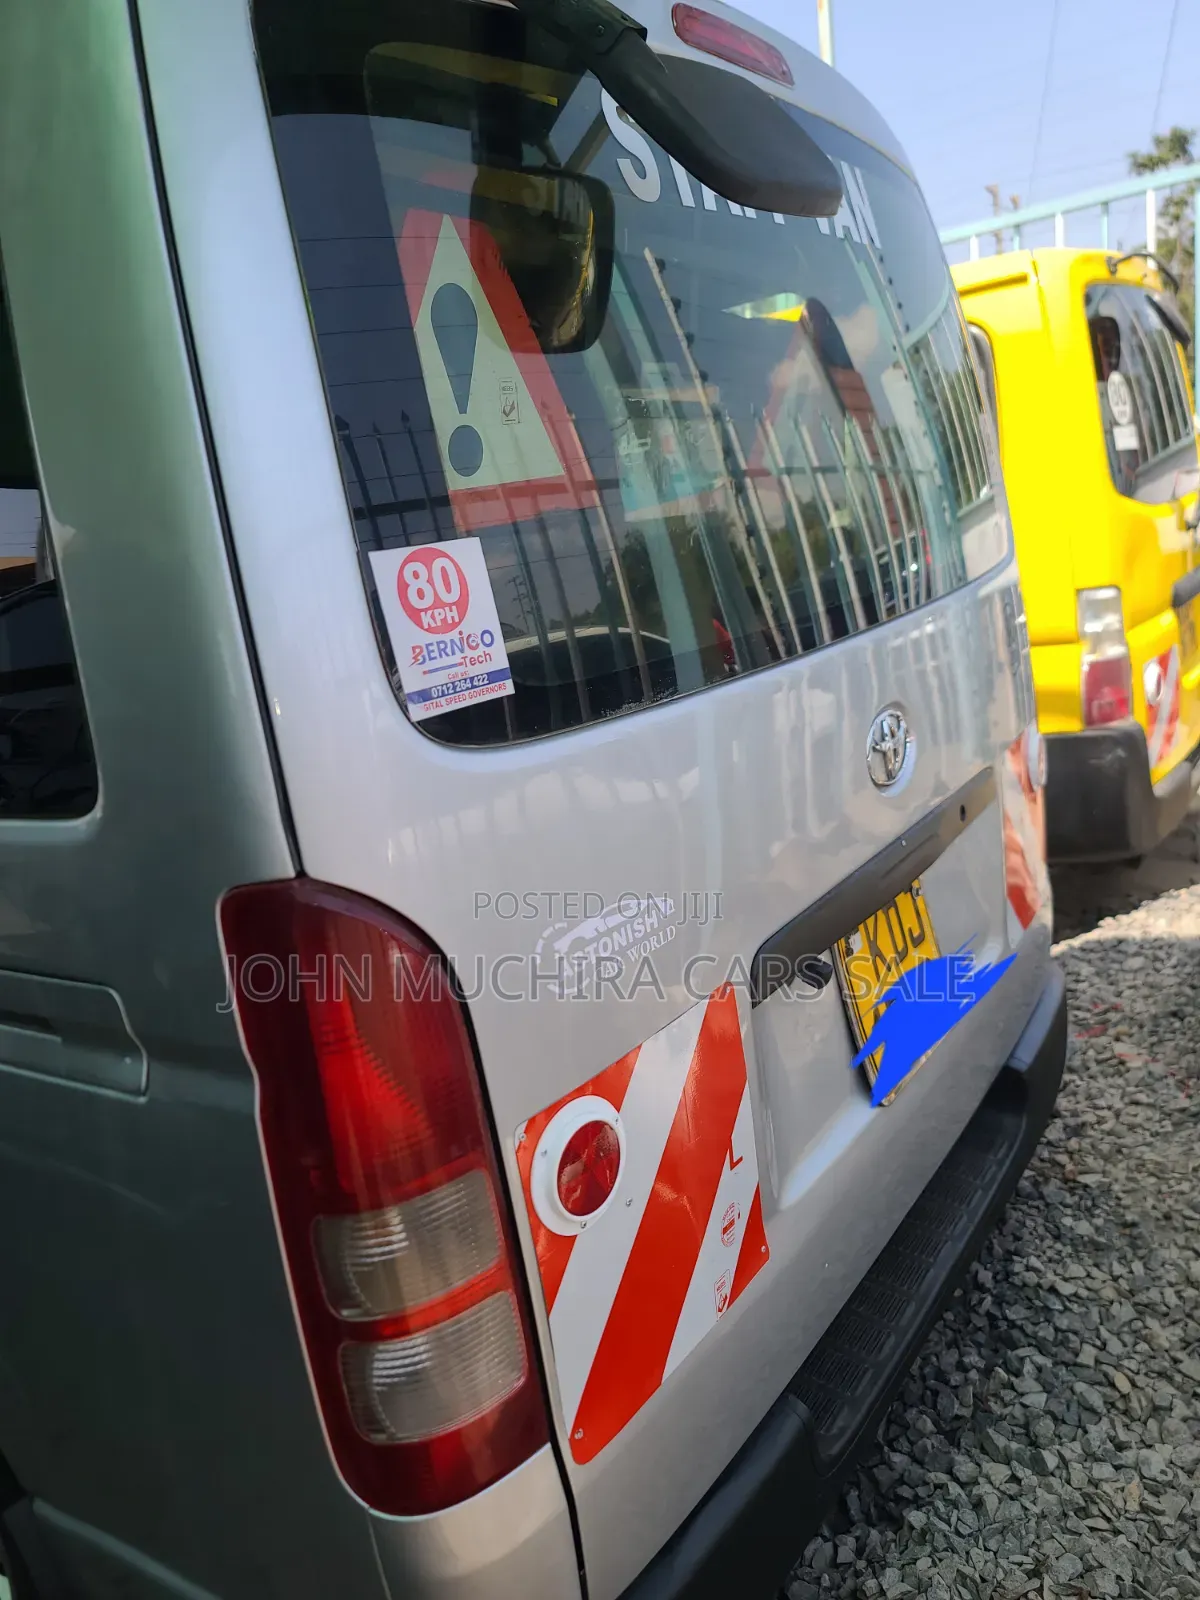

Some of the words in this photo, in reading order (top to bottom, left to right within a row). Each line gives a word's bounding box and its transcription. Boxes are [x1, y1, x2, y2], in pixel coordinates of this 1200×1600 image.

[815, 155, 882, 249] AN
[403, 557, 461, 610] 80
[420, 606, 460, 630] KPH
[461, 651, 493, 668] Tech
[431, 679, 455, 699] 0712
[455, 675, 472, 690] 264
[473, 673, 490, 686] 422
[447, 671, 460, 681] Call
[445, 694, 468, 706] SPEED
[469, 682, 507, 700] GOVERNORS
[627, 925, 677, 963] WORLD
